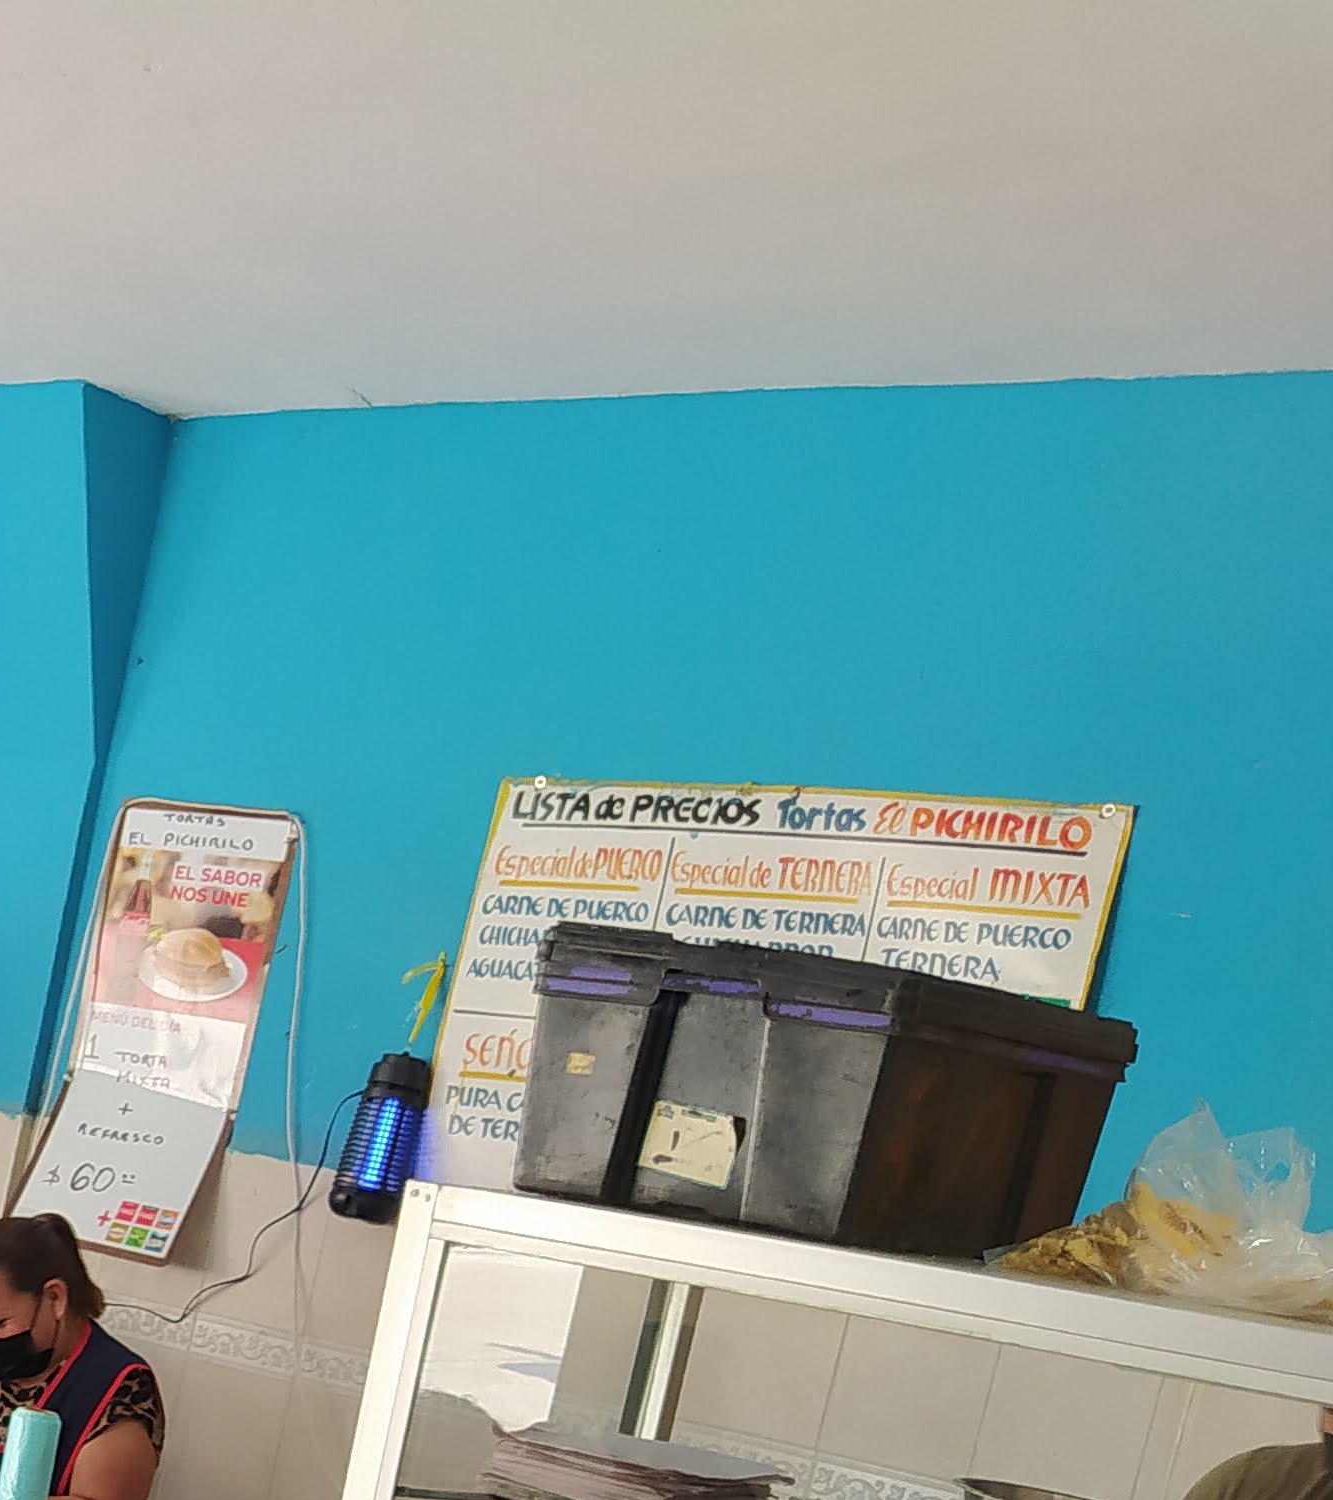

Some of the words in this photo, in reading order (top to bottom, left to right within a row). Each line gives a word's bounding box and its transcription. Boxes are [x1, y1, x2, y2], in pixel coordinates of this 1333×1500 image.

[164, 813, 225, 826] TORTAS
[511, 791, 590, 821] LISTA
[594, 793, 625, 822] de
[628, 794, 763, 827] PRECIOS
[777, 797, 867, 832] Tortas
[873, 801, 904, 835] El
[910, 806, 1092, 850] PICHIRILO
[129, 832, 150, 846] EL
[164, 833, 253, 851] PICHIRILO
[175, 866, 194, 881] EL
[201, 868, 262, 887] SABOR
[494, 845, 576, 879] Especial
[577, 850, 593, 879] de
[591, 847, 664, 882] PUERCO
[671, 851, 750, 888] Especial
[749, 856, 772, 888] de
[778, 857, 872, 895] TERNERA
[170, 886, 207, 903] NOS
[212, 891, 249, 907] UNE
[887, 863, 980, 901] Especial
[989, 868, 1090, 909] MIXTA
[482, 894, 543, 918] CARNE
[546, 897, 569, 919] DE
[573, 899, 649, 923] PUERCO
[666, 902, 738, 928] CARNE
[742, 907, 768, 930] DE
[773, 909, 865, 938] TERNERA
[877, 916, 938, 942] CARNE
[944, 921, 968, 943] DE
[976, 922, 1072, 950] PUERCO
[883, 948, 999, 981] TERNERA
[115, 1051, 167, 1068] TORTA
[446, 1085, 501, 1111] PURA
[78, 1122, 165, 1146] REFRESCO
[448, 1114, 476, 1136] DE
